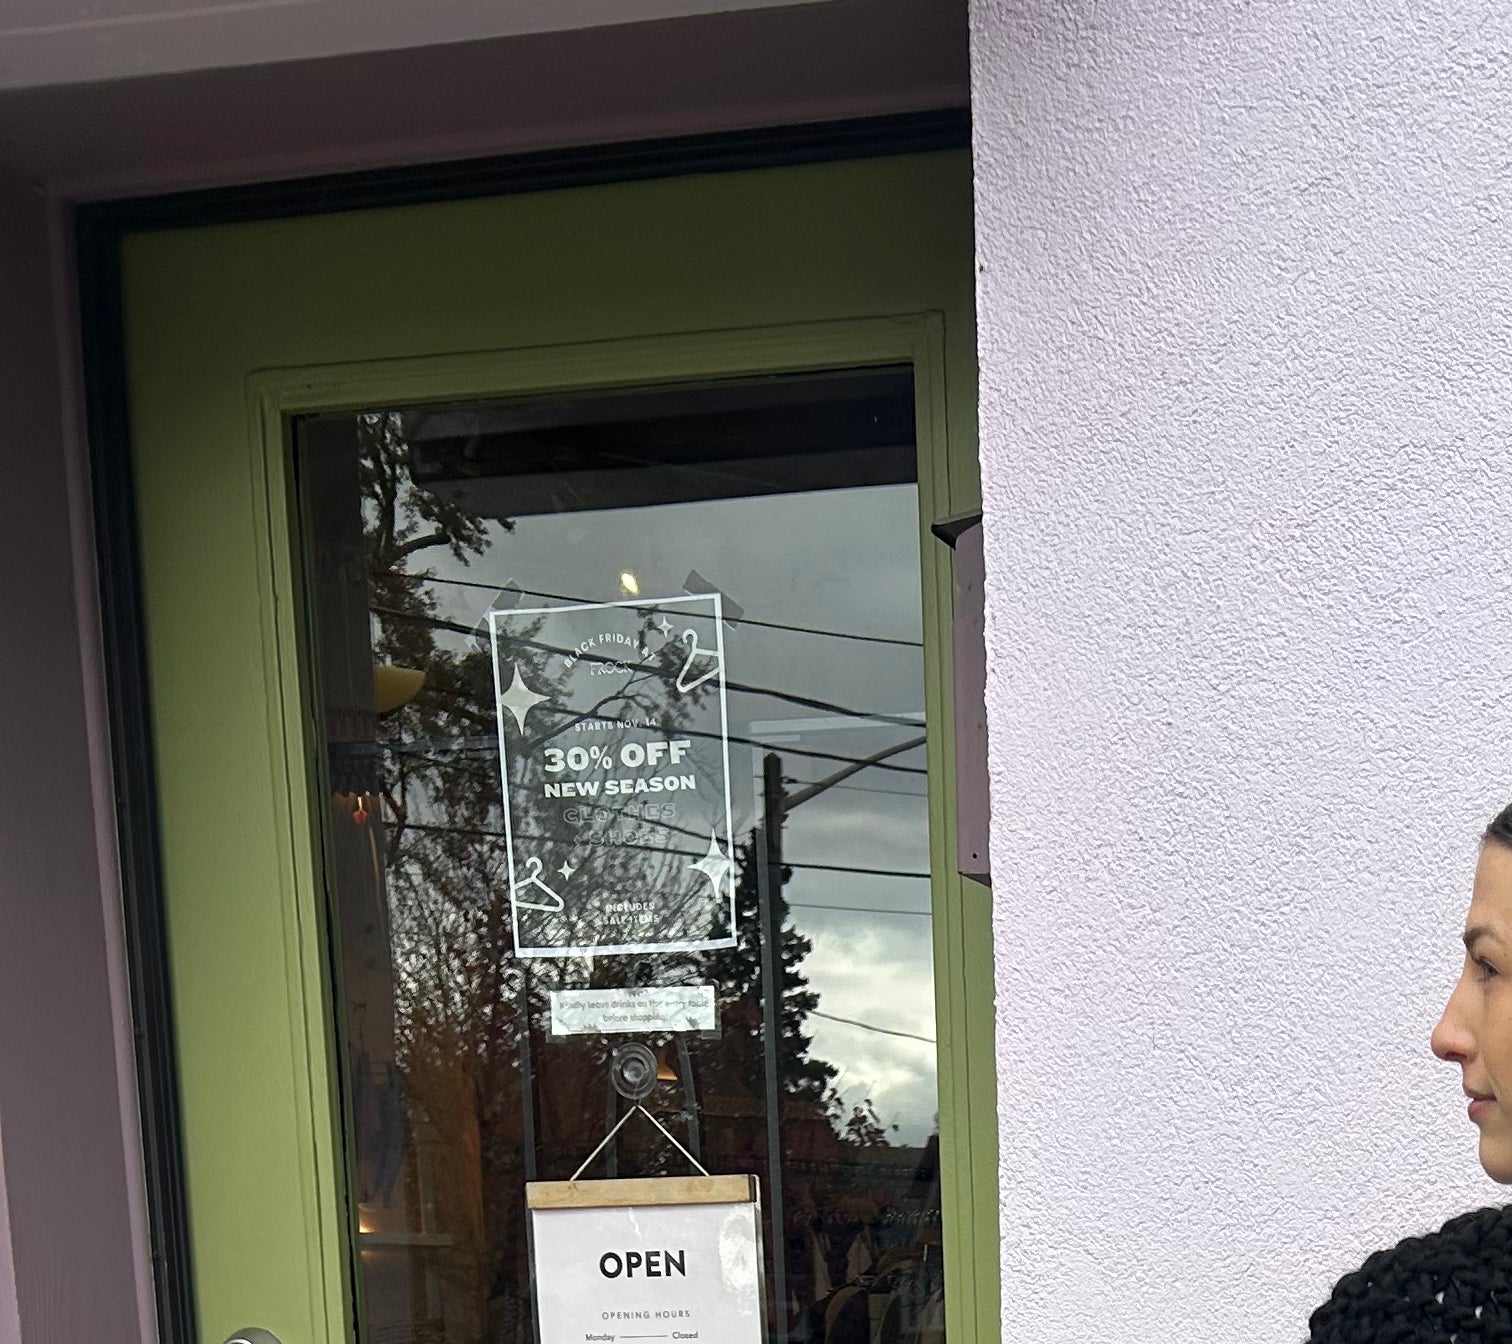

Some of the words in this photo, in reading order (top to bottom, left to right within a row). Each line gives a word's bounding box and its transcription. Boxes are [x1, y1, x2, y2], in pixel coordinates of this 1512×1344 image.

[563, 638, 596, 668] BLACK
[599, 633, 640, 649] FRIDAY
[574, 721, 614, 732] STARTS
[543, 745, 613, 773] 30%
[620, 739, 693, 768] OFF
[543, 781, 600, 798] NEW
[604, 774, 697, 796] SEASON
[599, 1249, 686, 1279] OPEN
[601, 1311, 650, 1320] OPENING
[655, 1310, 691, 1319] HOURS
[585, 1333, 616, 1343] Monday
[672, 1331, 699, 1340] Closed
